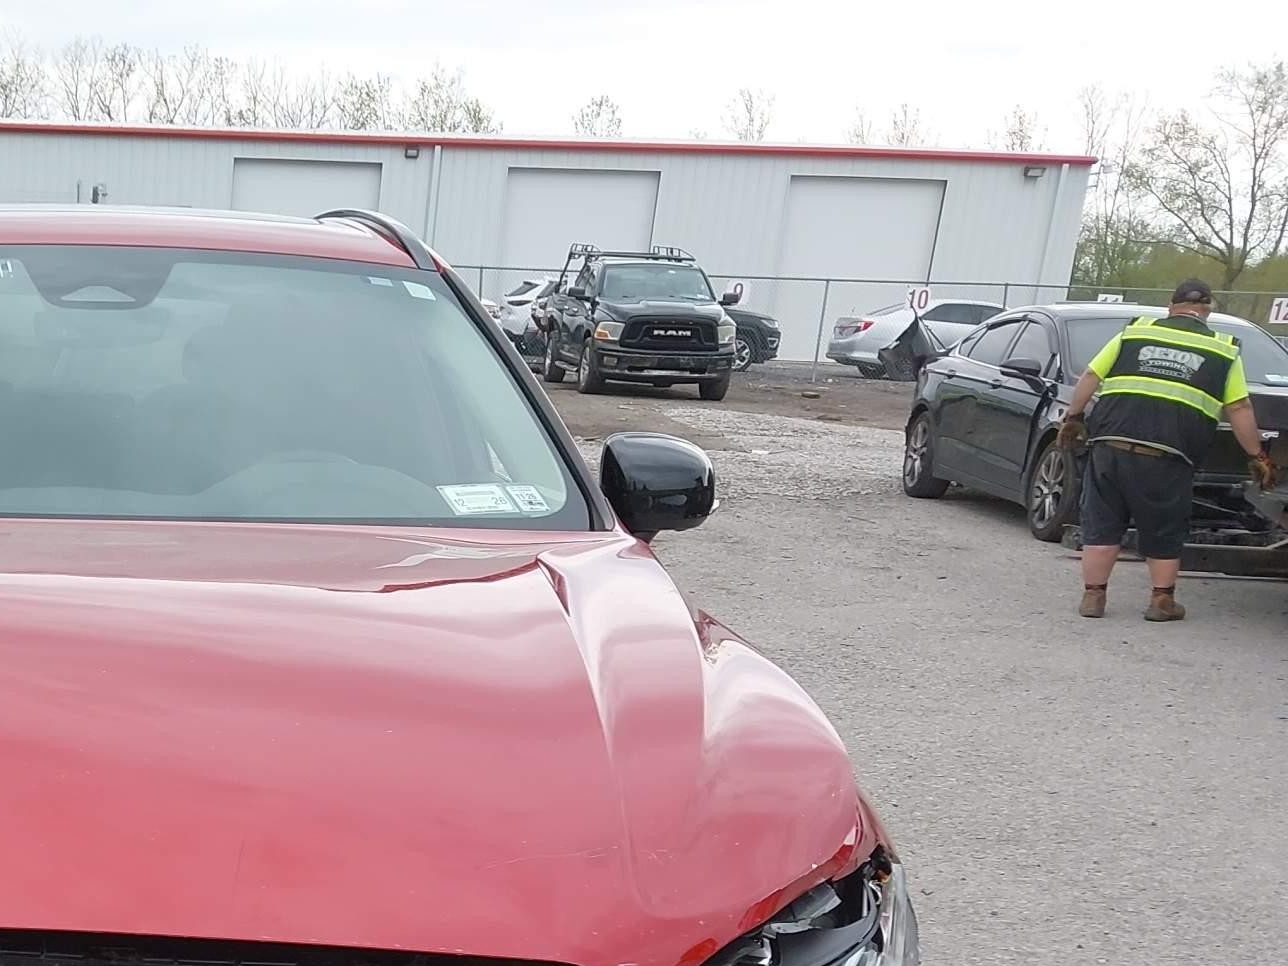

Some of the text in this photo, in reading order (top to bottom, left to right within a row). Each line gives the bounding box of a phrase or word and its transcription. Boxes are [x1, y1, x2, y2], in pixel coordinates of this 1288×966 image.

[909, 289, 929, 309] 10
[653, 329, 692, 337] RAM
[1138, 345, 1207, 372] SETON
